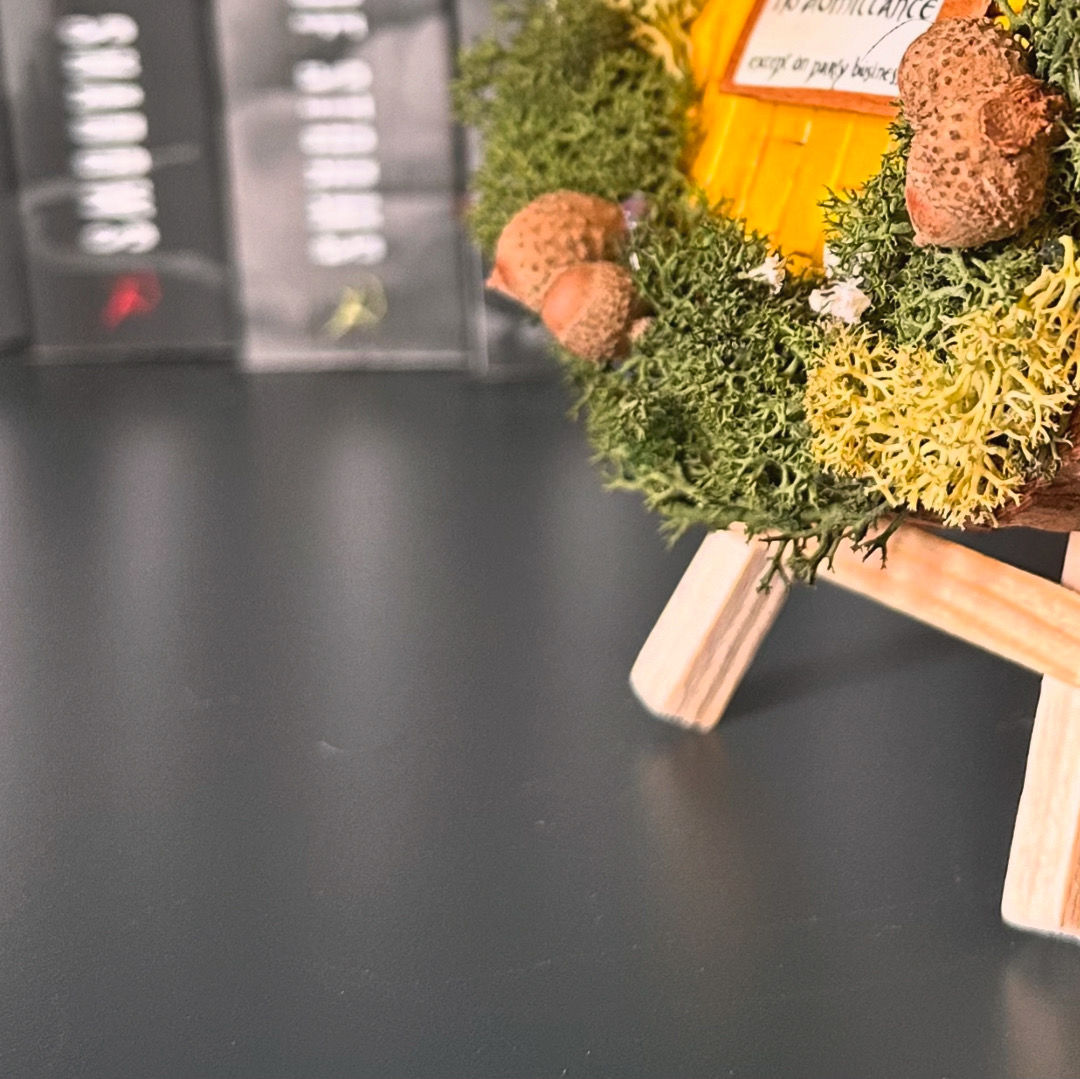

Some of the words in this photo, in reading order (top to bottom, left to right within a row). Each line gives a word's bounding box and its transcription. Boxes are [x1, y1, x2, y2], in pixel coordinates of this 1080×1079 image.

[57, 13, 160, 256] SHADOWS
[294, 58, 387, 266] STORMS
[748, 54, 791, 81] except
[792, 57, 810, 71] on
[805, 58, 849, 89] party
